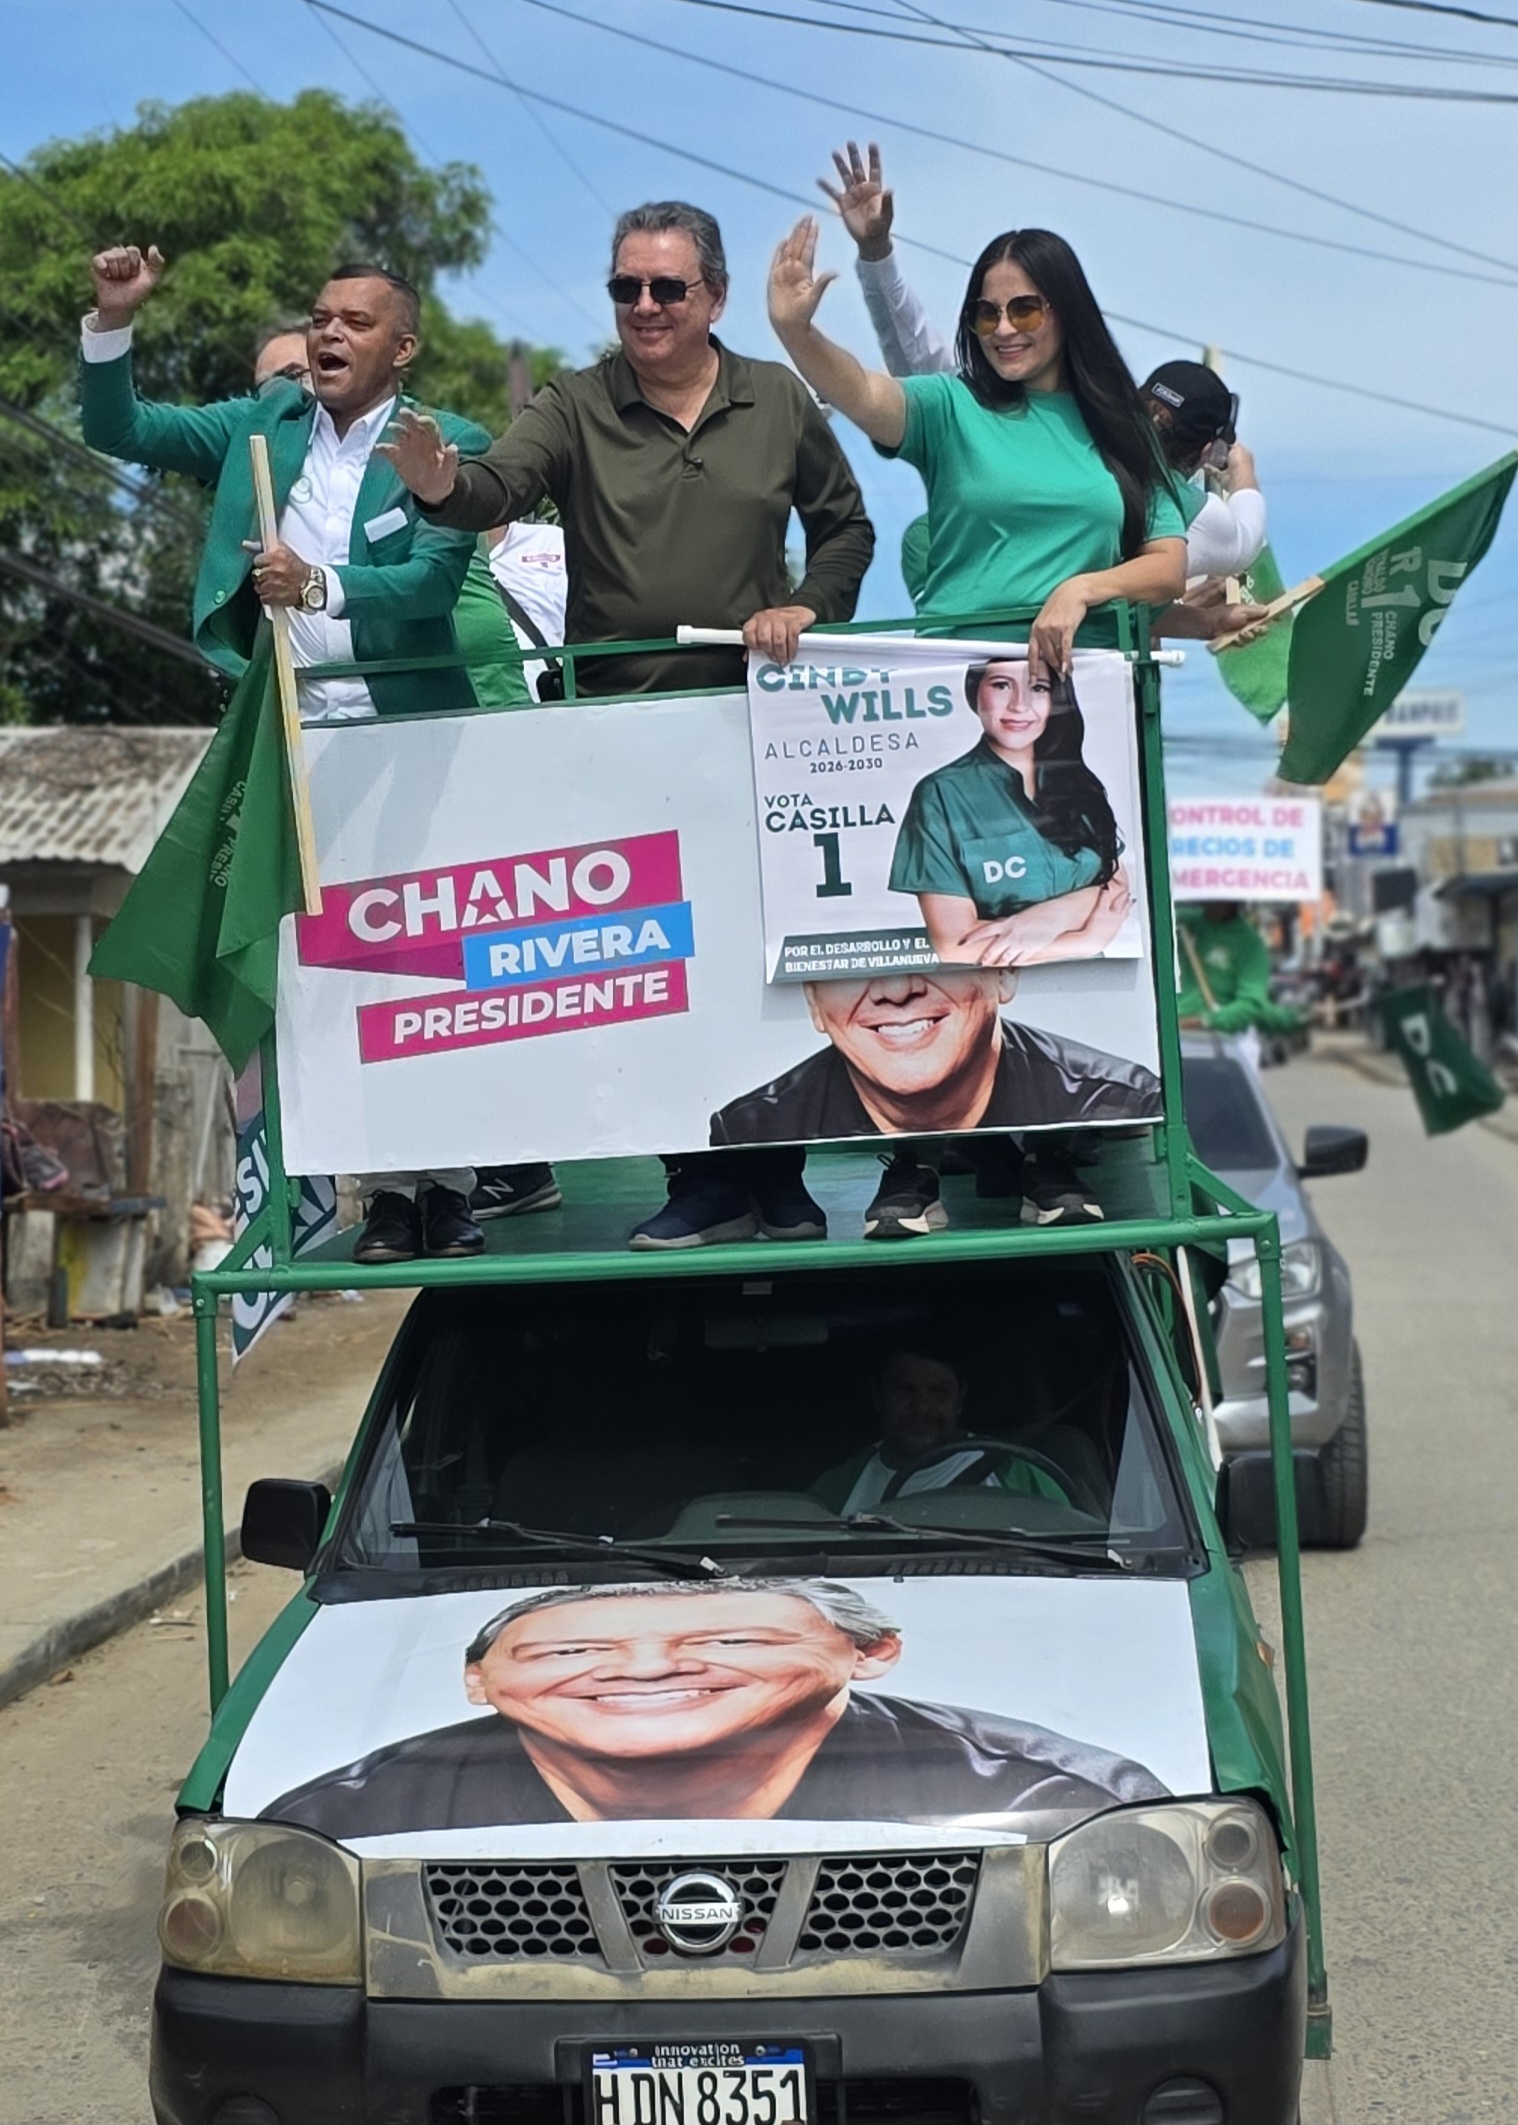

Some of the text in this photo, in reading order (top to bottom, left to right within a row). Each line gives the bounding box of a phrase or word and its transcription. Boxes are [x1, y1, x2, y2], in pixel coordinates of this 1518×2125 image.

[1383, 610, 1398, 660] CHANO
[1363, 611, 1384, 697] PRESIDENTE
[820, 685, 953, 725] WILLS
[765, 732, 919, 760] ALCALDESA
[810, 757, 883, 774] 2026-2030
[764, 793, 814, 809] VOTA
[765, 803, 896, 833] CASILLA
[1171, 806, 1303, 828] ONTROL DE
[1171, 837, 1294, 858] RECIOS DE
[813, 832, 853, 898] 1
[983, 855, 1027, 884] DC
[1174, 867, 1310, 890] MERGENCIA
[348, 850, 632, 943] CHANO
[489, 919, 672, 978] RIVERA
[785, 945, 809, 957] POR
[826, 940, 901, 955] DESARROLLO
[903, 939, 911, 949] Y
[914, 937, 930, 949] EL
[785, 952, 940, 973] BIENESTAR DE VILLANUEVA
[393, 970, 669, 1045] PRESIDENTE
[662, 1908, 733, 1921] NISSAN
[651, 2054, 746, 2068] that excites
[696, 2069, 805, 2125] 8351
